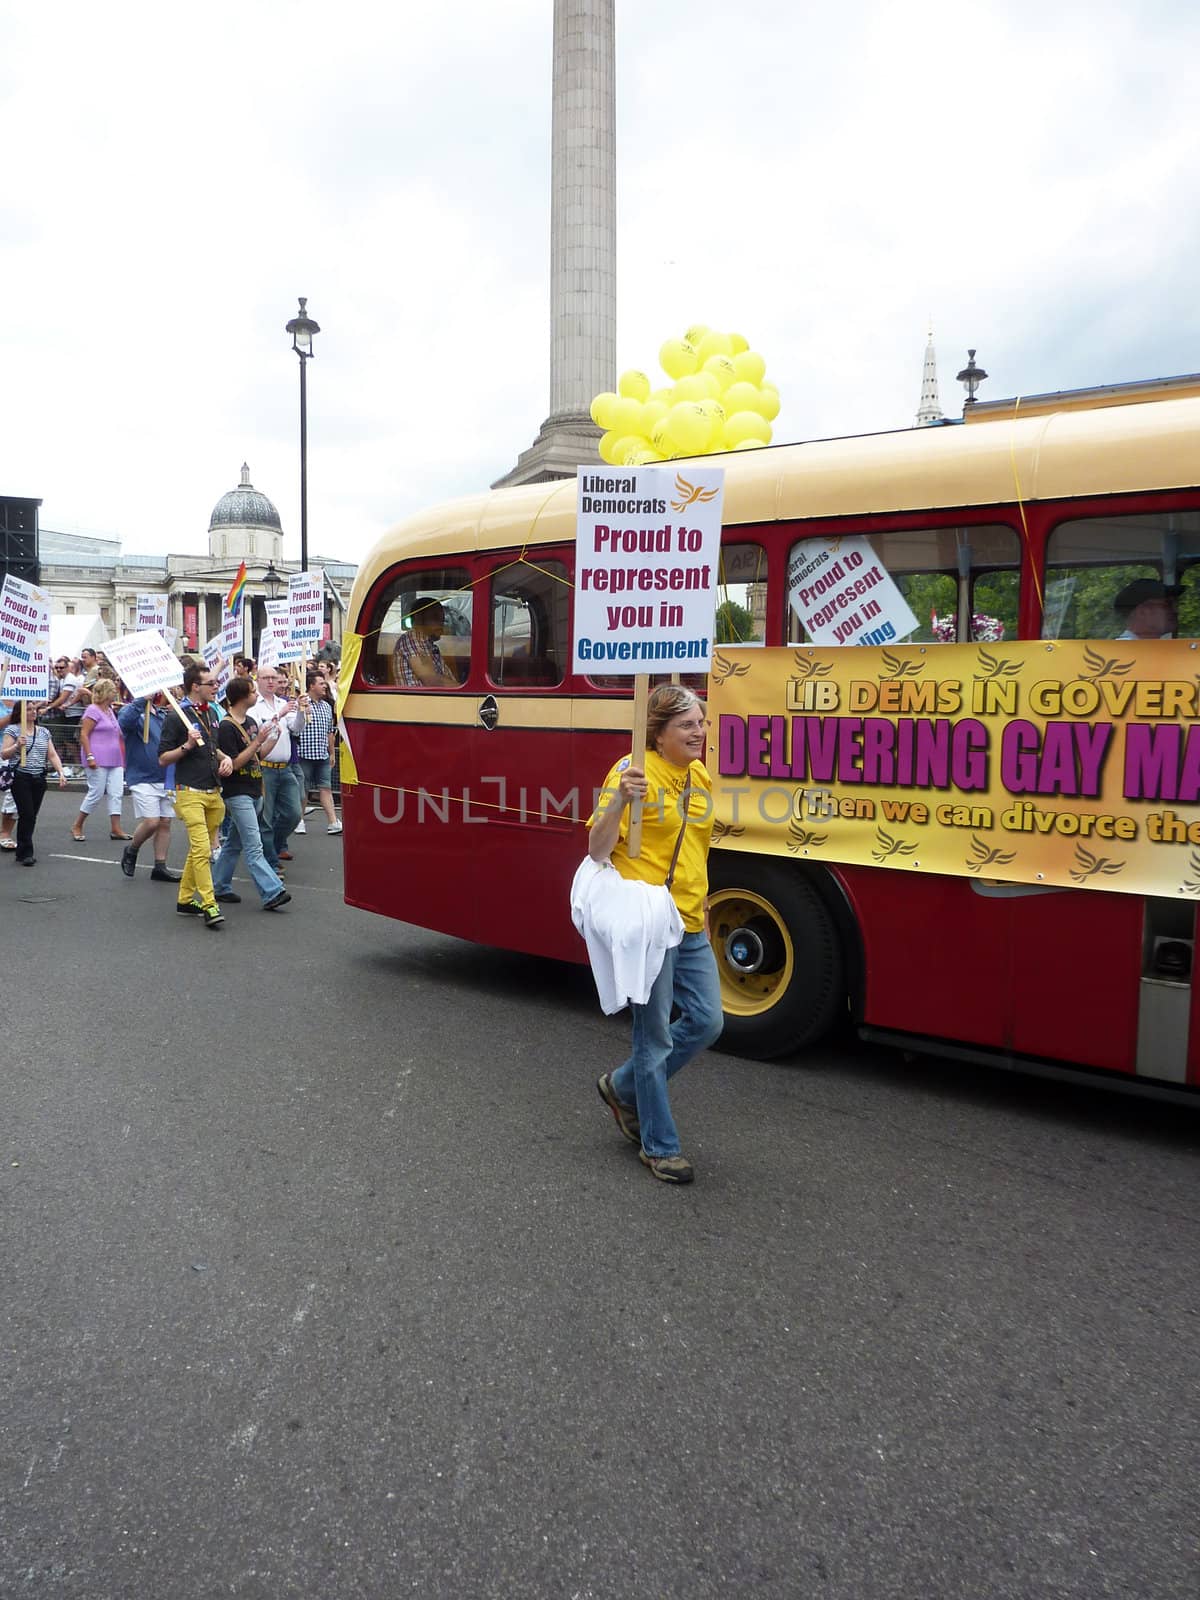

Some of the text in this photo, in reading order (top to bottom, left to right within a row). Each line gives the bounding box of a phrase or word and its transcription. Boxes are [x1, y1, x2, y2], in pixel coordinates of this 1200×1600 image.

[582, 476, 636, 493] Liberal
[582, 497, 666, 514] Democrats
[594, 525, 703, 553] Proud to
[581, 565, 711, 594] represent
[798, 561, 846, 608] Proud
[842, 551, 864, 571] to
[292, 589, 320, 601] Proud to
[806, 566, 884, 633] represent
[4, 595, 38, 619] Proud to
[289, 602, 322, 615] represent
[606, 601, 684, 631] you in
[295, 615, 316, 627] you in
[832, 600, 882, 645] you in
[1, 627, 26, 644] you in
[291, 629, 321, 640] Hackney
[855, 620, 897, 646] ling
[34, 652, 43, 661] to
[577, 638, 709, 660] Government
[2, 687, 47, 697] Richmond
[10, 676, 38, 685] you in
[786, 680, 1200, 717] LIB DEMS IN GOVER
[718, 713, 988, 790] DELIVERING
[1001, 718, 1113, 796] GAY
[792, 787, 875, 820] (Then
[881, 800, 929, 824] we
[936, 804, 993, 828] can
[1001, 801, 1137, 839] divorce
